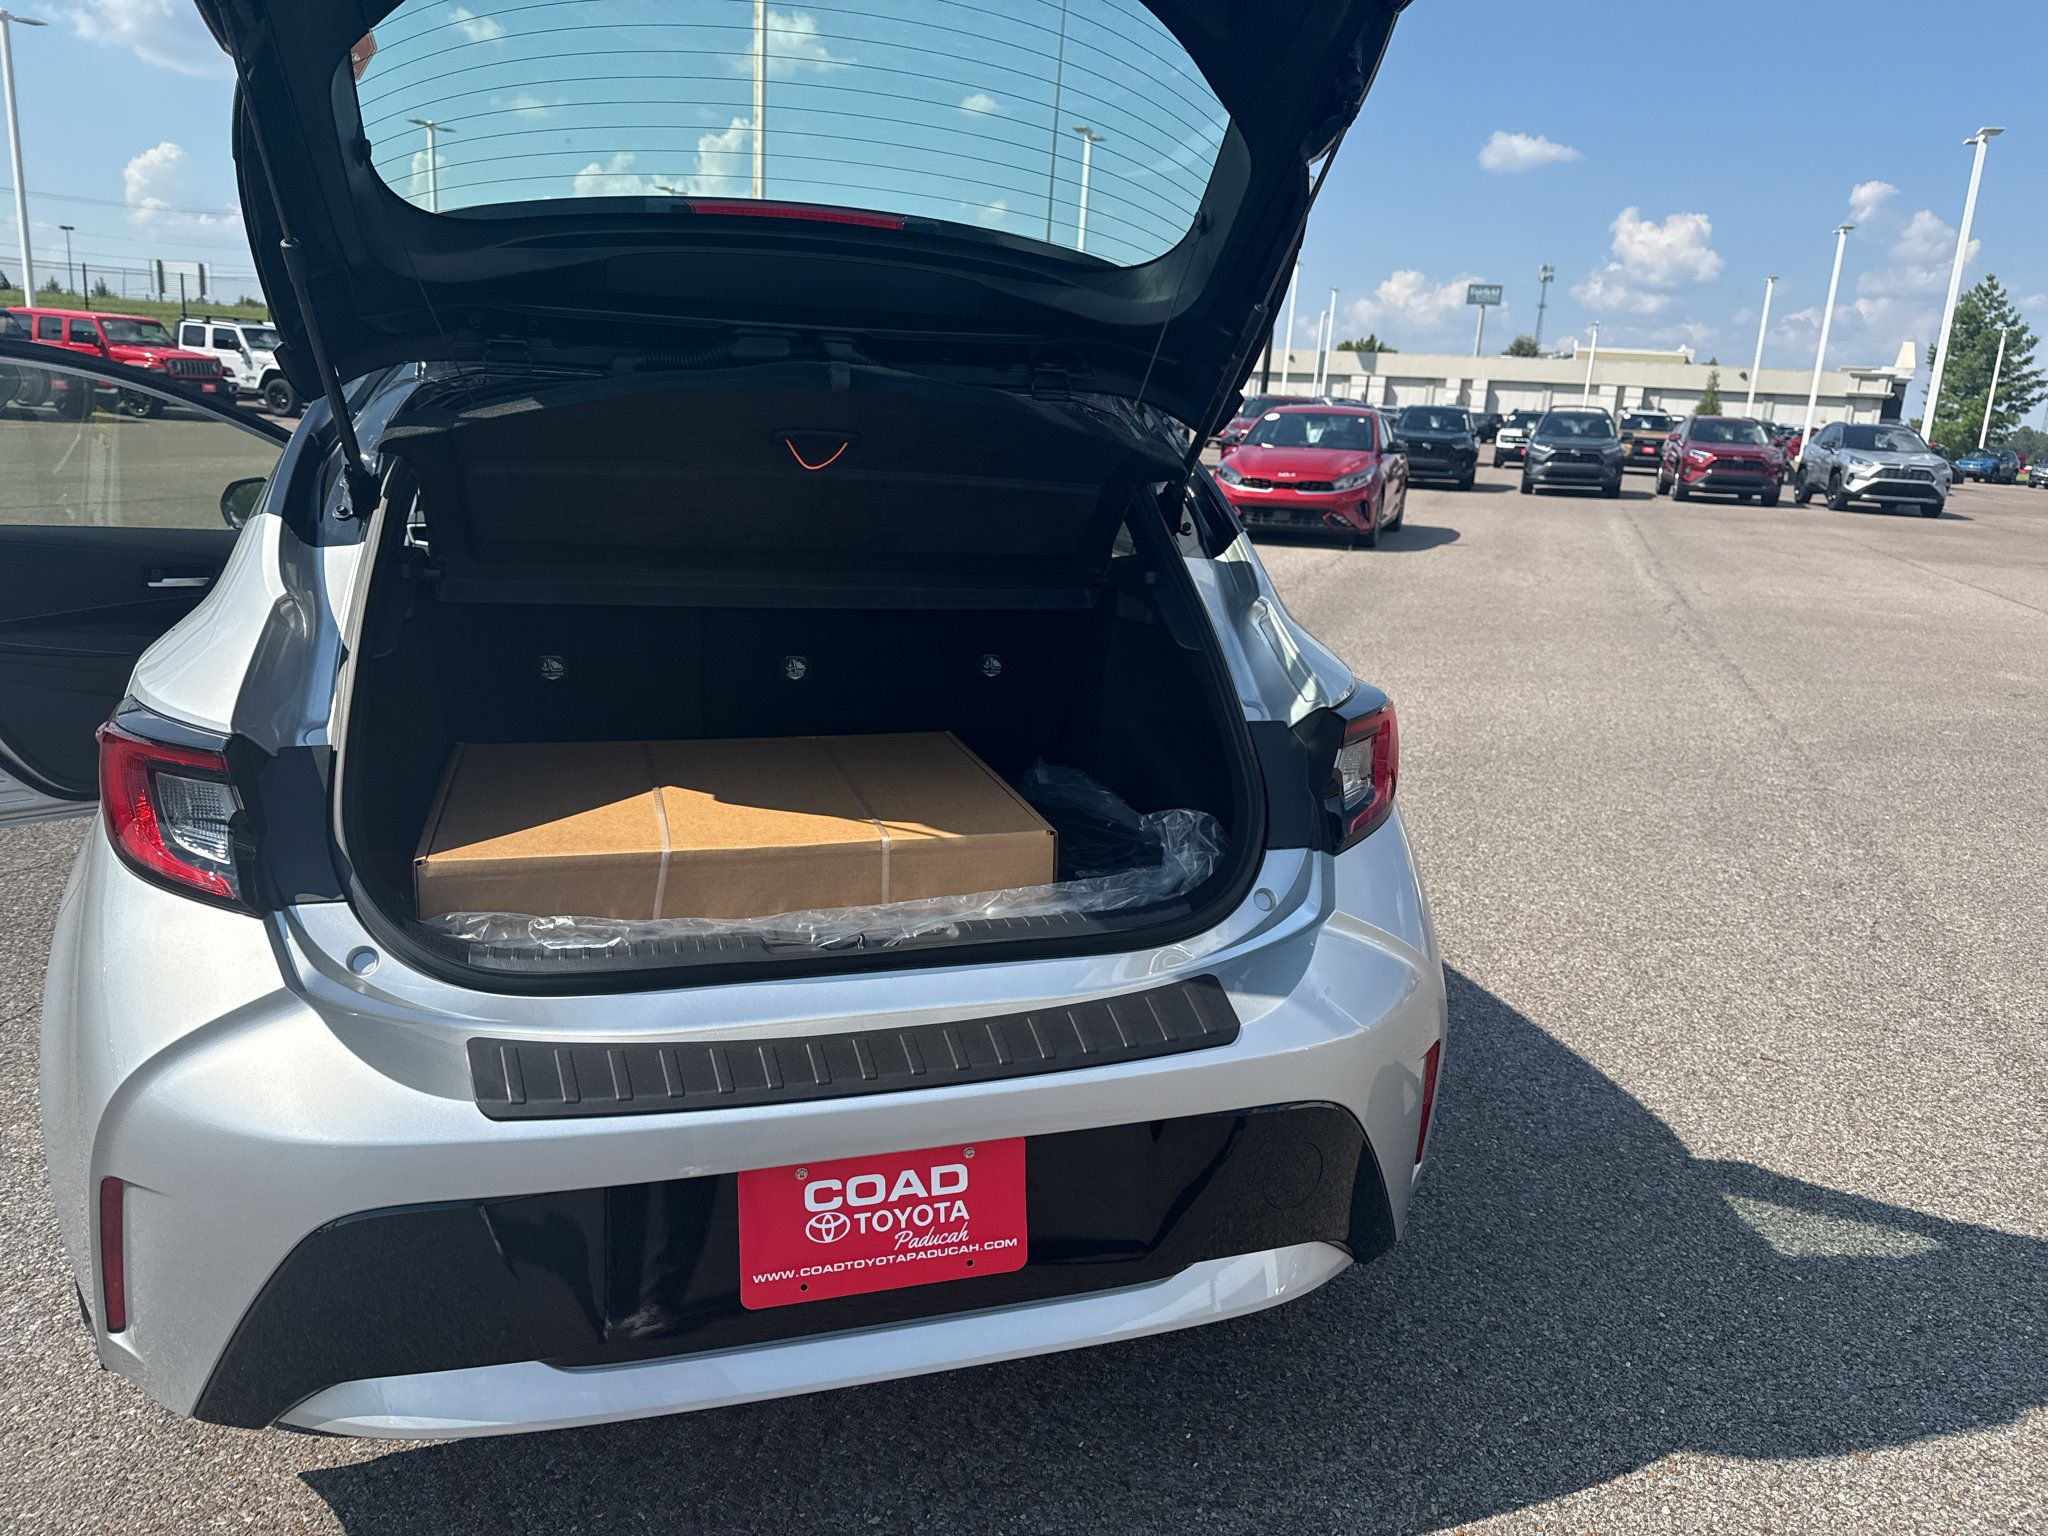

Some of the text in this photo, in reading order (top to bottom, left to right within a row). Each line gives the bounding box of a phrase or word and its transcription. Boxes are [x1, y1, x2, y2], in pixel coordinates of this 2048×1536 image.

[804, 1163, 969, 1213] COAD
[853, 1200, 970, 1234] TOYOTA
[894, 1221, 969, 1251] Paducah
[752, 1238, 1018, 1284] WWW.COADTOYOTAPADUCAH.COM
